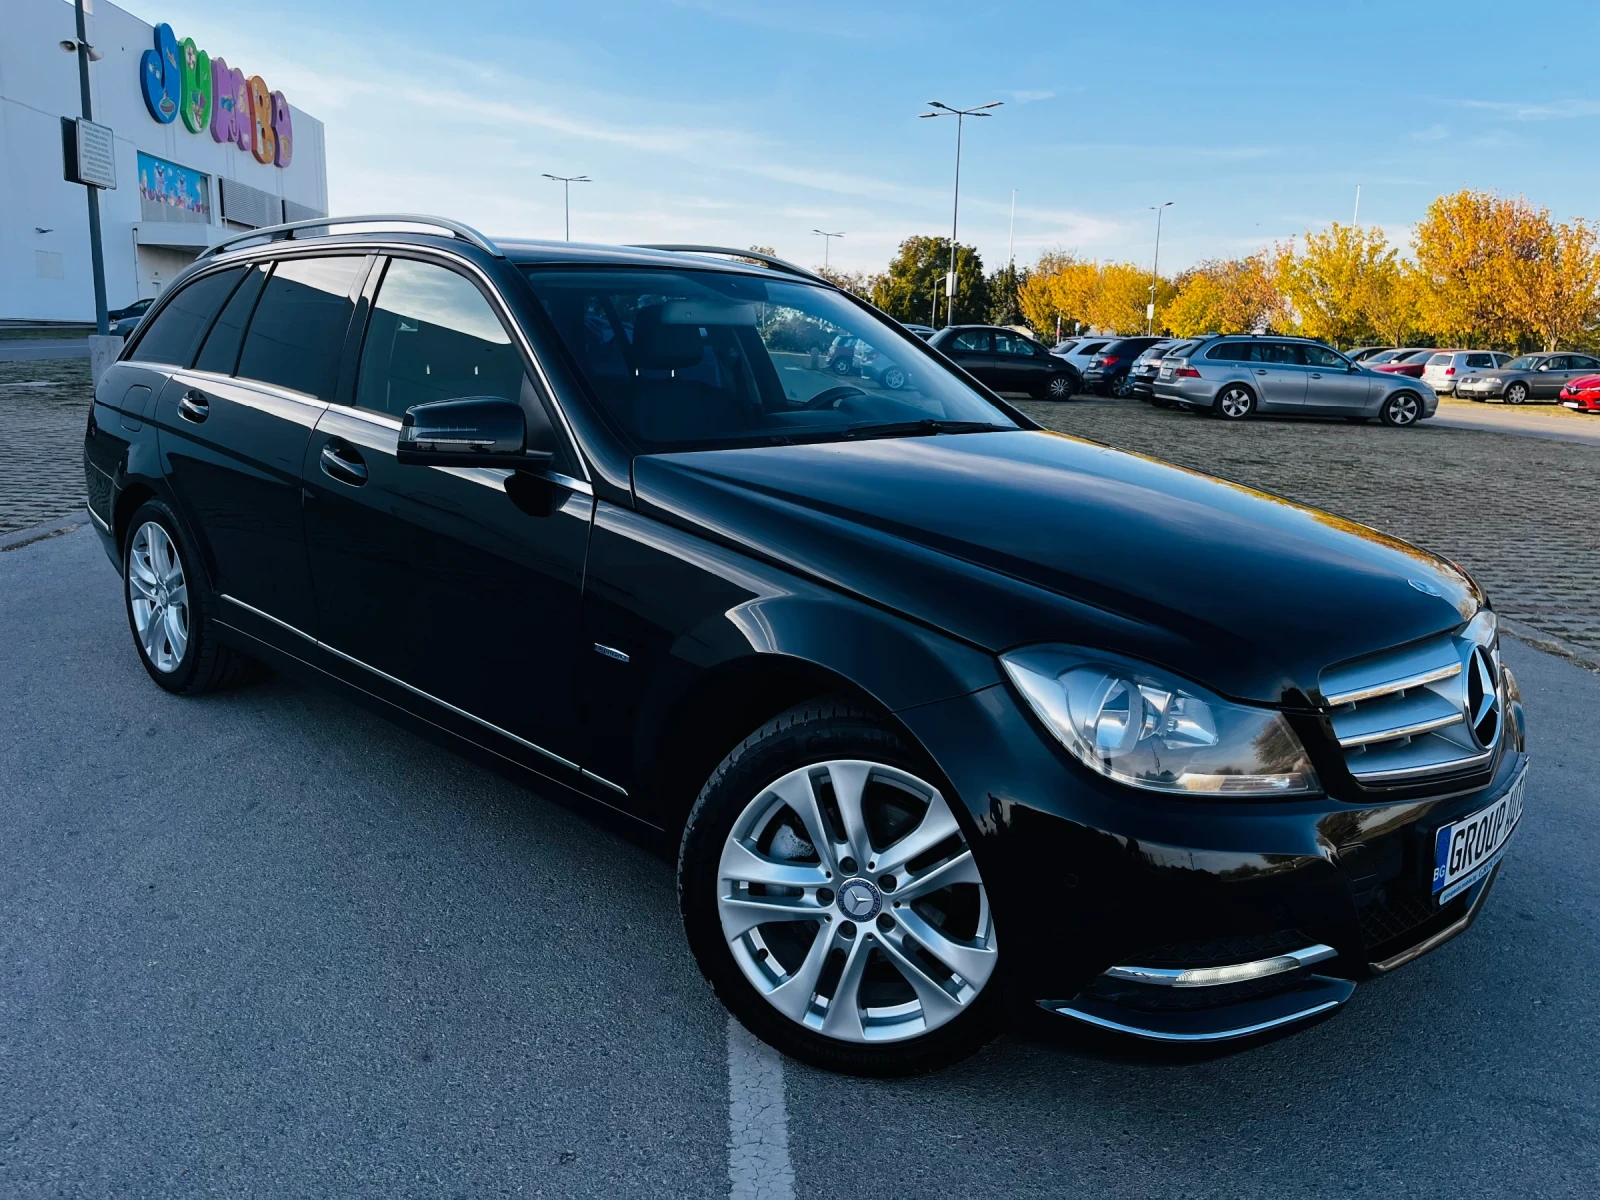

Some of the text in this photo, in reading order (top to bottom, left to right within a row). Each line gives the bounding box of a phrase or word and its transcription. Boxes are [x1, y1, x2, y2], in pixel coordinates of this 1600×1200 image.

[139, 22, 293, 168] JUMBO
[1433, 865, 1446, 882] BG
[1449, 801, 1507, 876] GROUP
